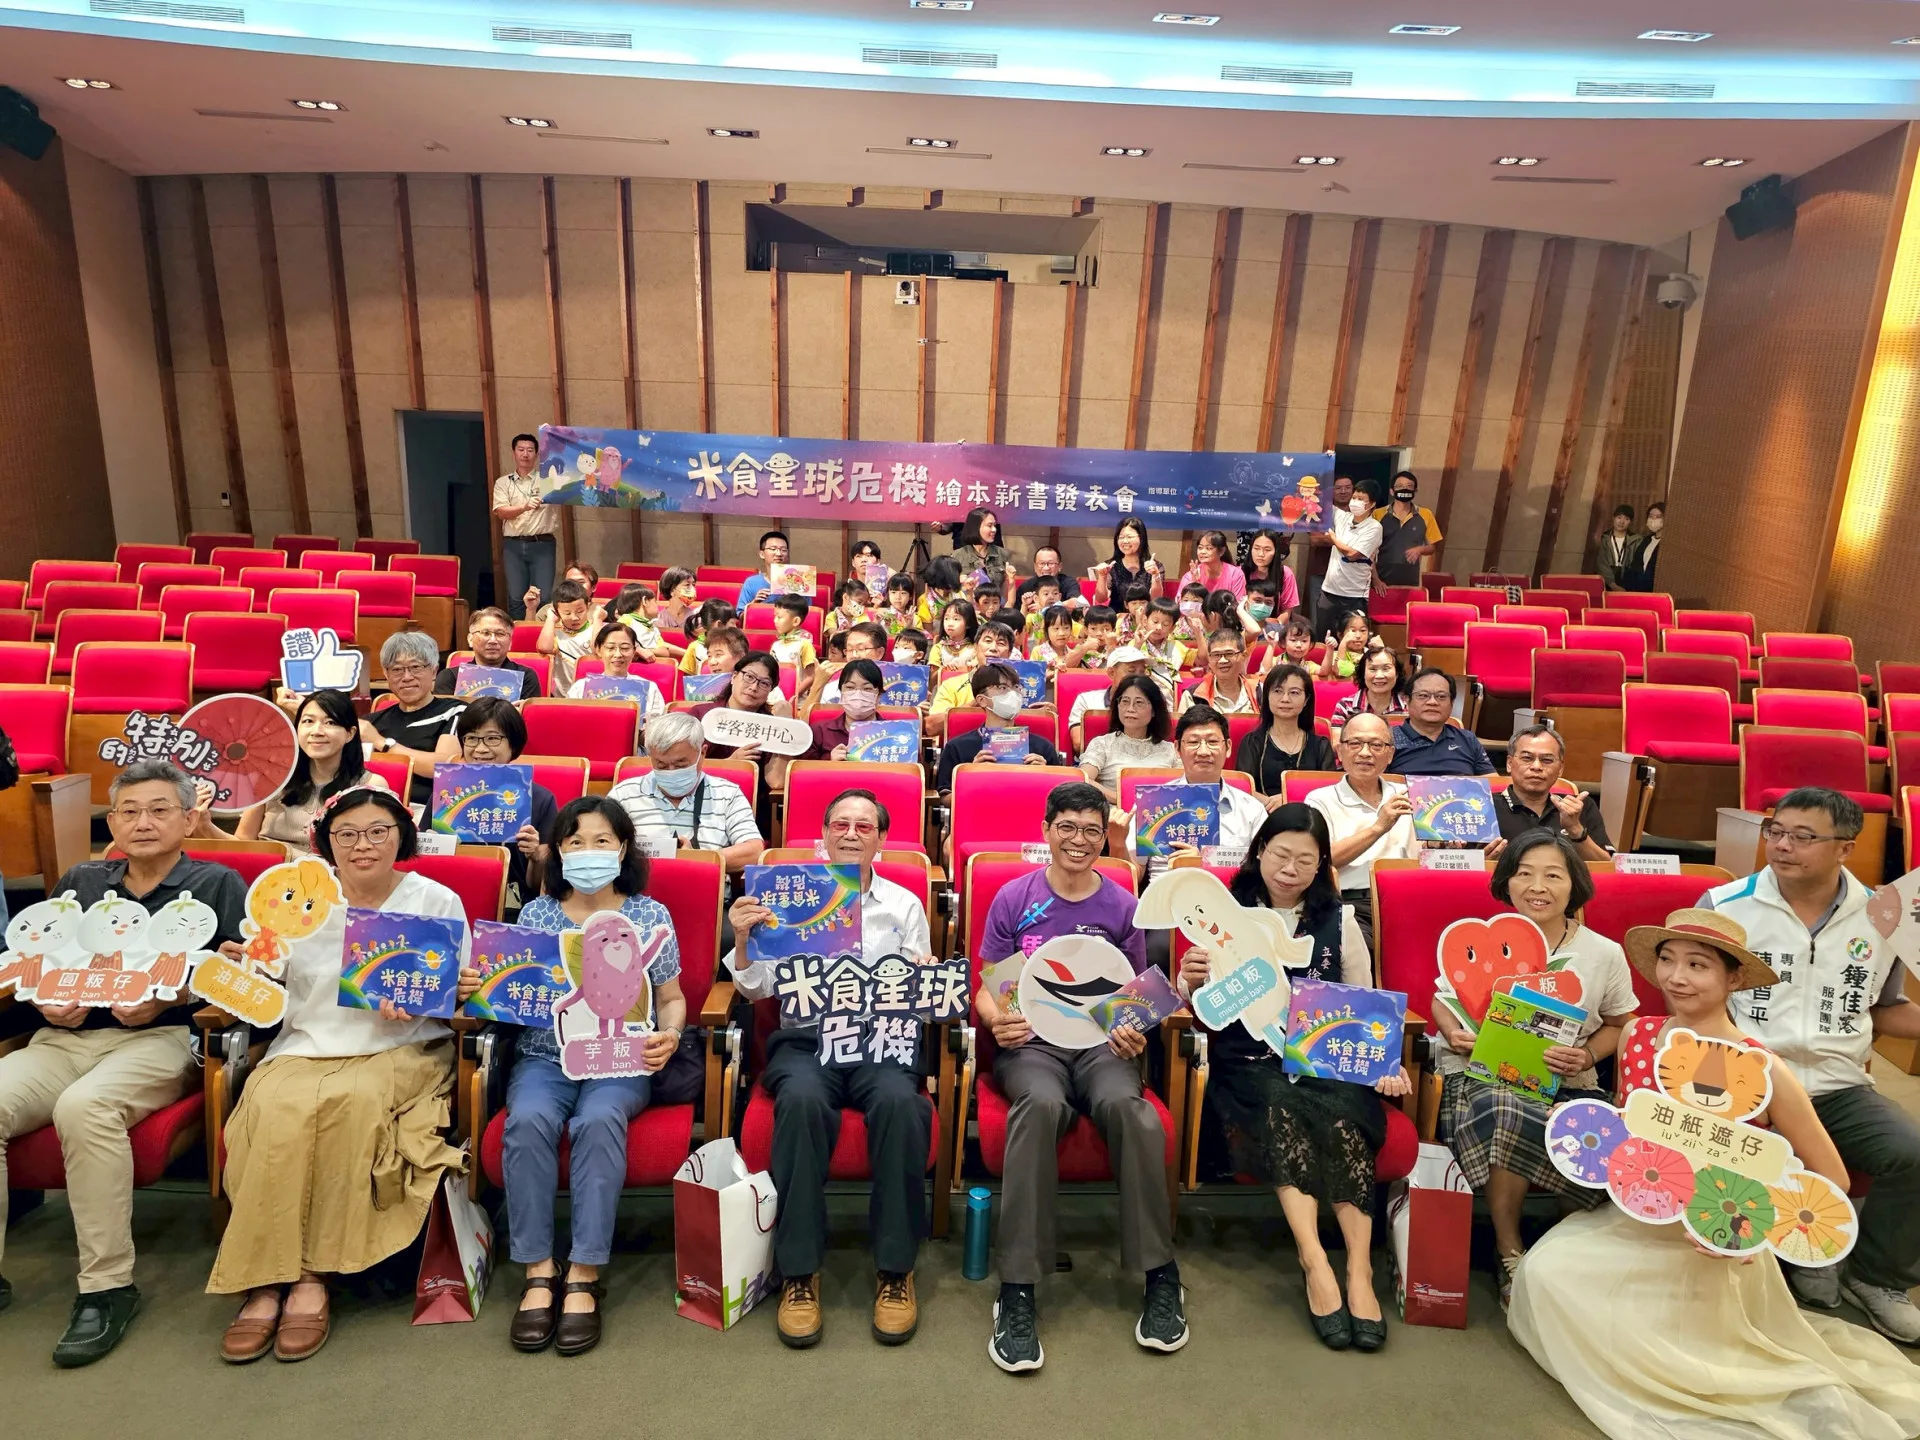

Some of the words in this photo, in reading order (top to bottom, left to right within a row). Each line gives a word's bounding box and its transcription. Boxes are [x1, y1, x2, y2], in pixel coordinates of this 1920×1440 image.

[687, 451, 928, 506] 米食星球危機
[936, 477, 1139, 513] 繪本新書發表會
[285, 631, 315, 658] 讚
[716, 719, 794, 744] #客發中心
[467, 807, 517, 823] 米食星球
[1442, 811, 1487, 826] 米食星球
[478, 822, 505, 835] 危機
[1166, 823, 1209, 838] 米食星球
[1455, 824, 1478, 836] 危機
[380, 968, 441, 992] 米食星球
[1780, 953, 1794, 984] 專員
[392, 987, 424, 1006] 危機
[778, 958, 968, 1018] 米食星球
[1207, 965, 1262, 1008] 面帕粄
[518, 1001, 550, 1020] 危機
[1819, 986, 1835, 1034] 服務團隊
[584, 1042, 630, 1060] 芋粄
[819, 1015, 918, 1067] 危機
[1326, 1037, 1386, 1062] 米食星球
[586, 1063, 599, 1071] vu
[1338, 1056, 1370, 1076] 危機
[1651, 1102, 1763, 1156] 油紙遮仔
